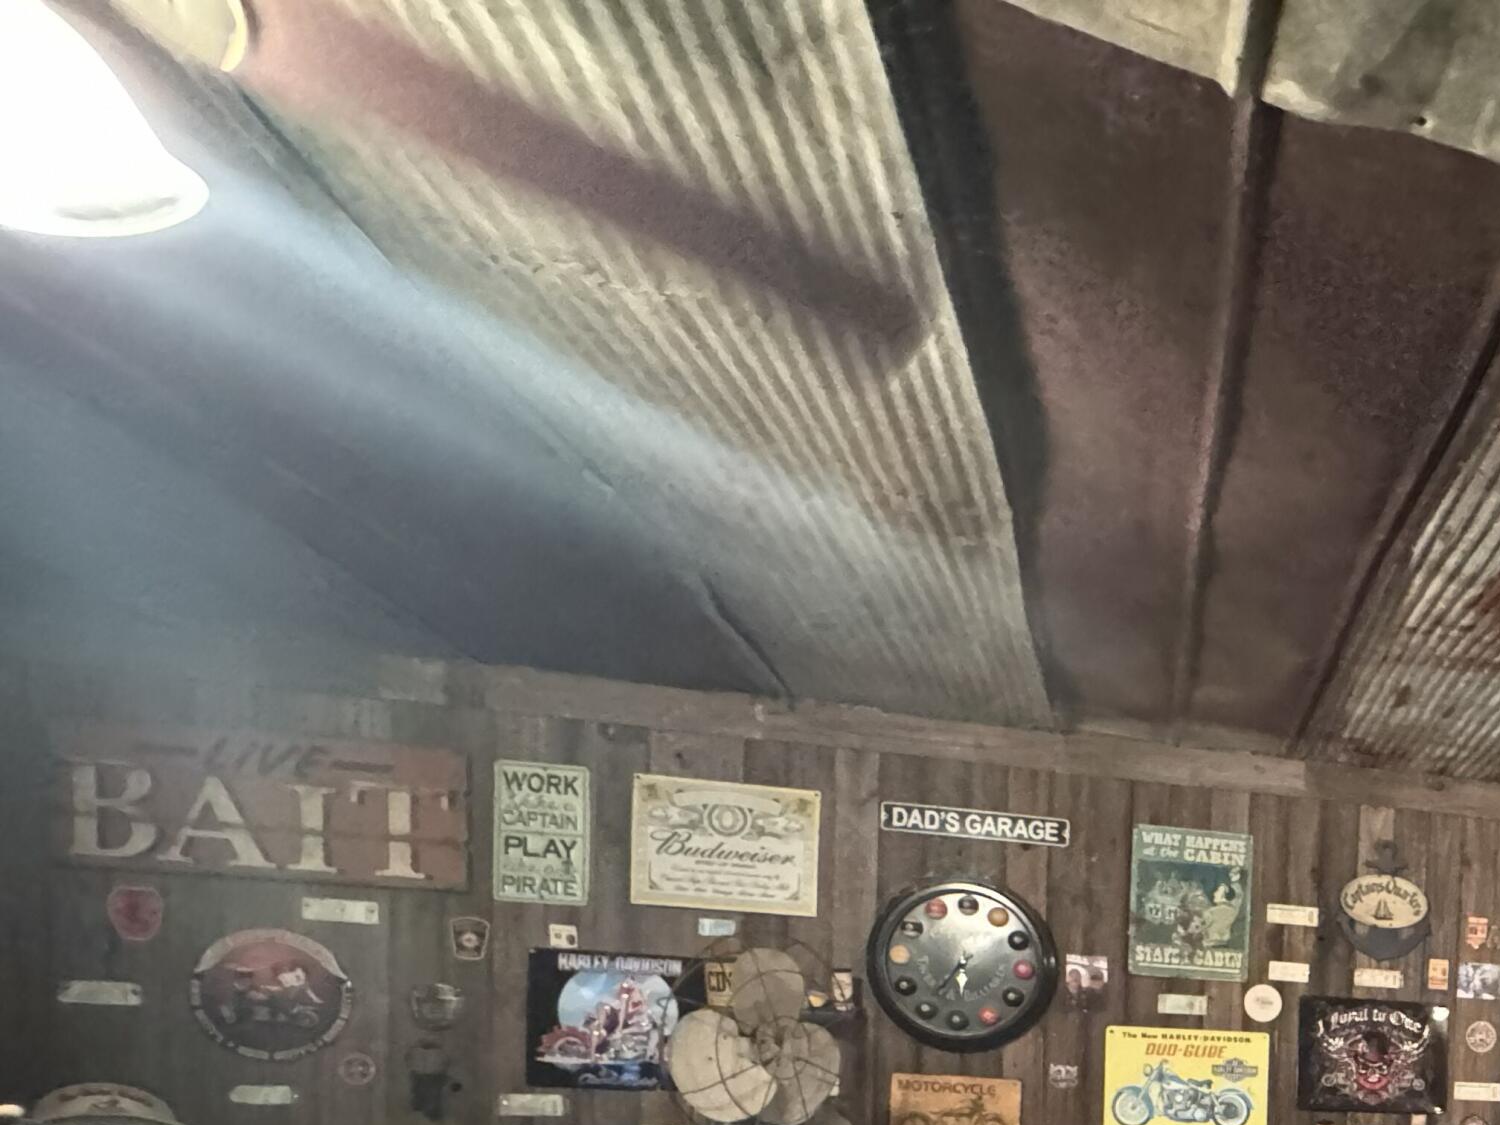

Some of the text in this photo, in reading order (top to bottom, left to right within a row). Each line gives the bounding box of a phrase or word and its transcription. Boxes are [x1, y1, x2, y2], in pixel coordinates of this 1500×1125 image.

[503, 770, 579, 797] WORK
[66, 758, 450, 880] BAIT
[502, 809, 578, 831] CAPTAIN
[892, 806, 1059, 842] DAD'S GARAGE
[504, 835, 577, 859] PLAY
[649, 829, 798, 866] Budweiser
[1141, 831, 1247, 853] WHAT HAPPENS
[1183, 849, 1246, 866] CABIN
[502, 875, 577, 897] PIRATE
[1145, 1042, 1227, 1059] DUO-GLIDE
[897, 1079, 997, 1097] MOTORCYCLE
